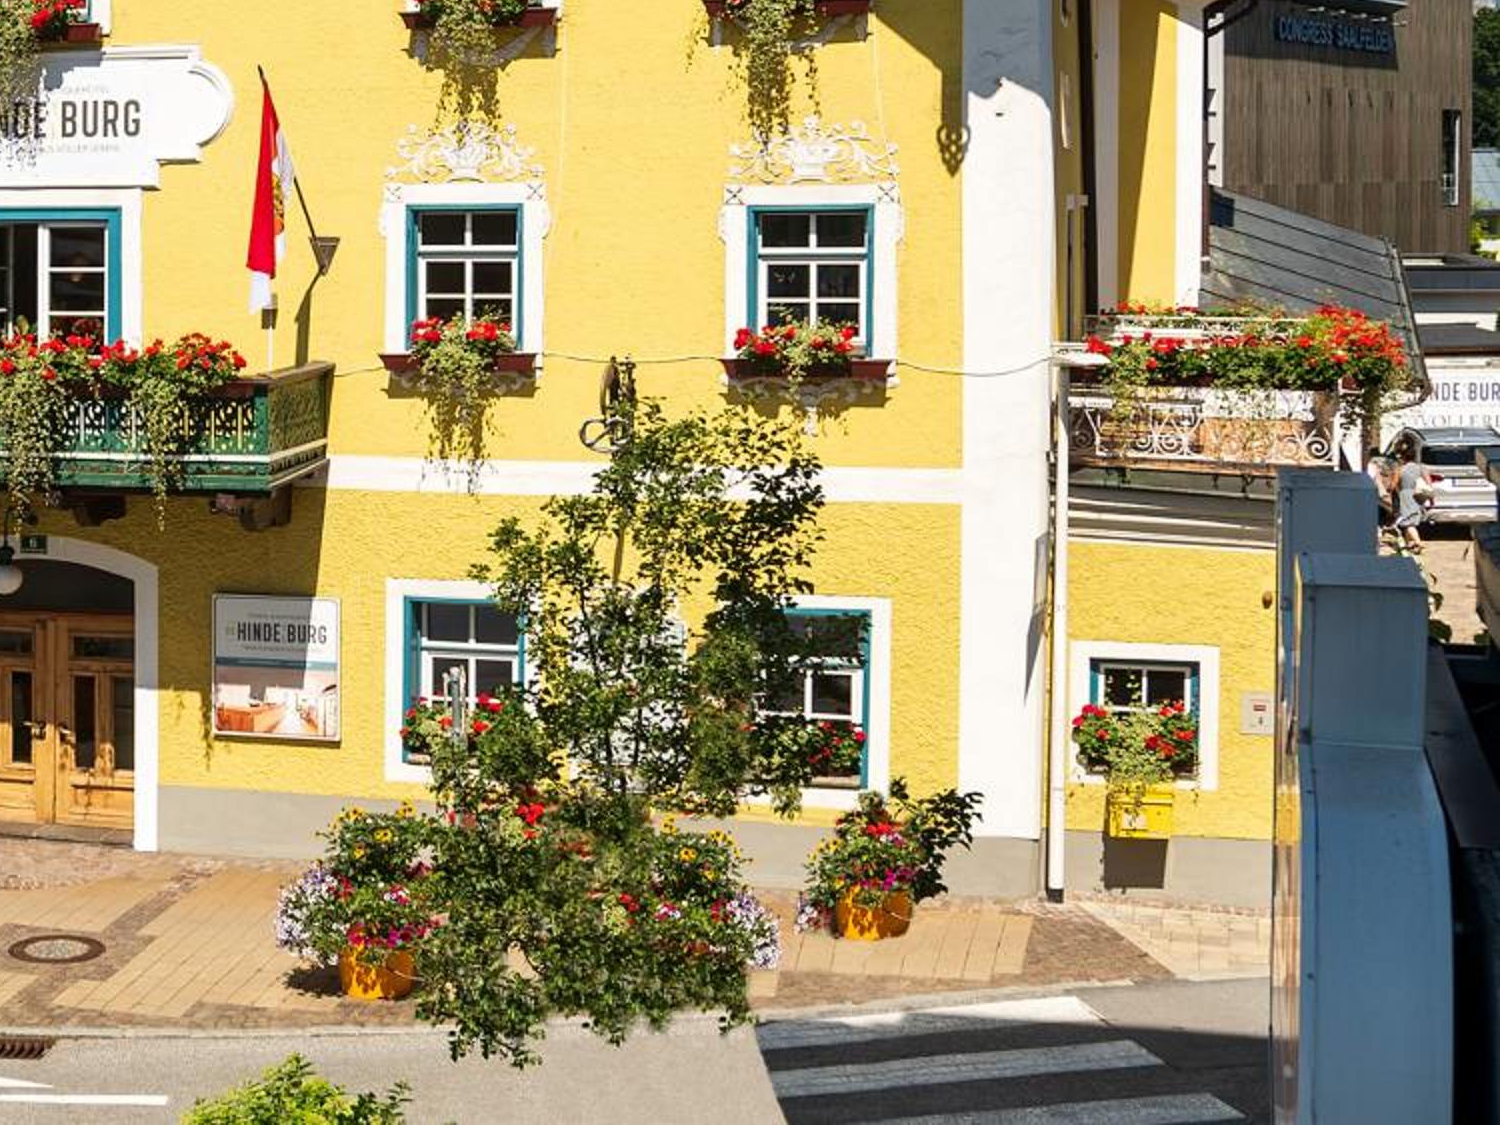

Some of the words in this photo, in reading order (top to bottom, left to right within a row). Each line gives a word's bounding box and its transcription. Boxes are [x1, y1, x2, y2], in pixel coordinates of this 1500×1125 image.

[60, 99, 142, 138] BURG
[237, 621, 281, 643] HINDE
[286, 624, 328, 645] BURG
